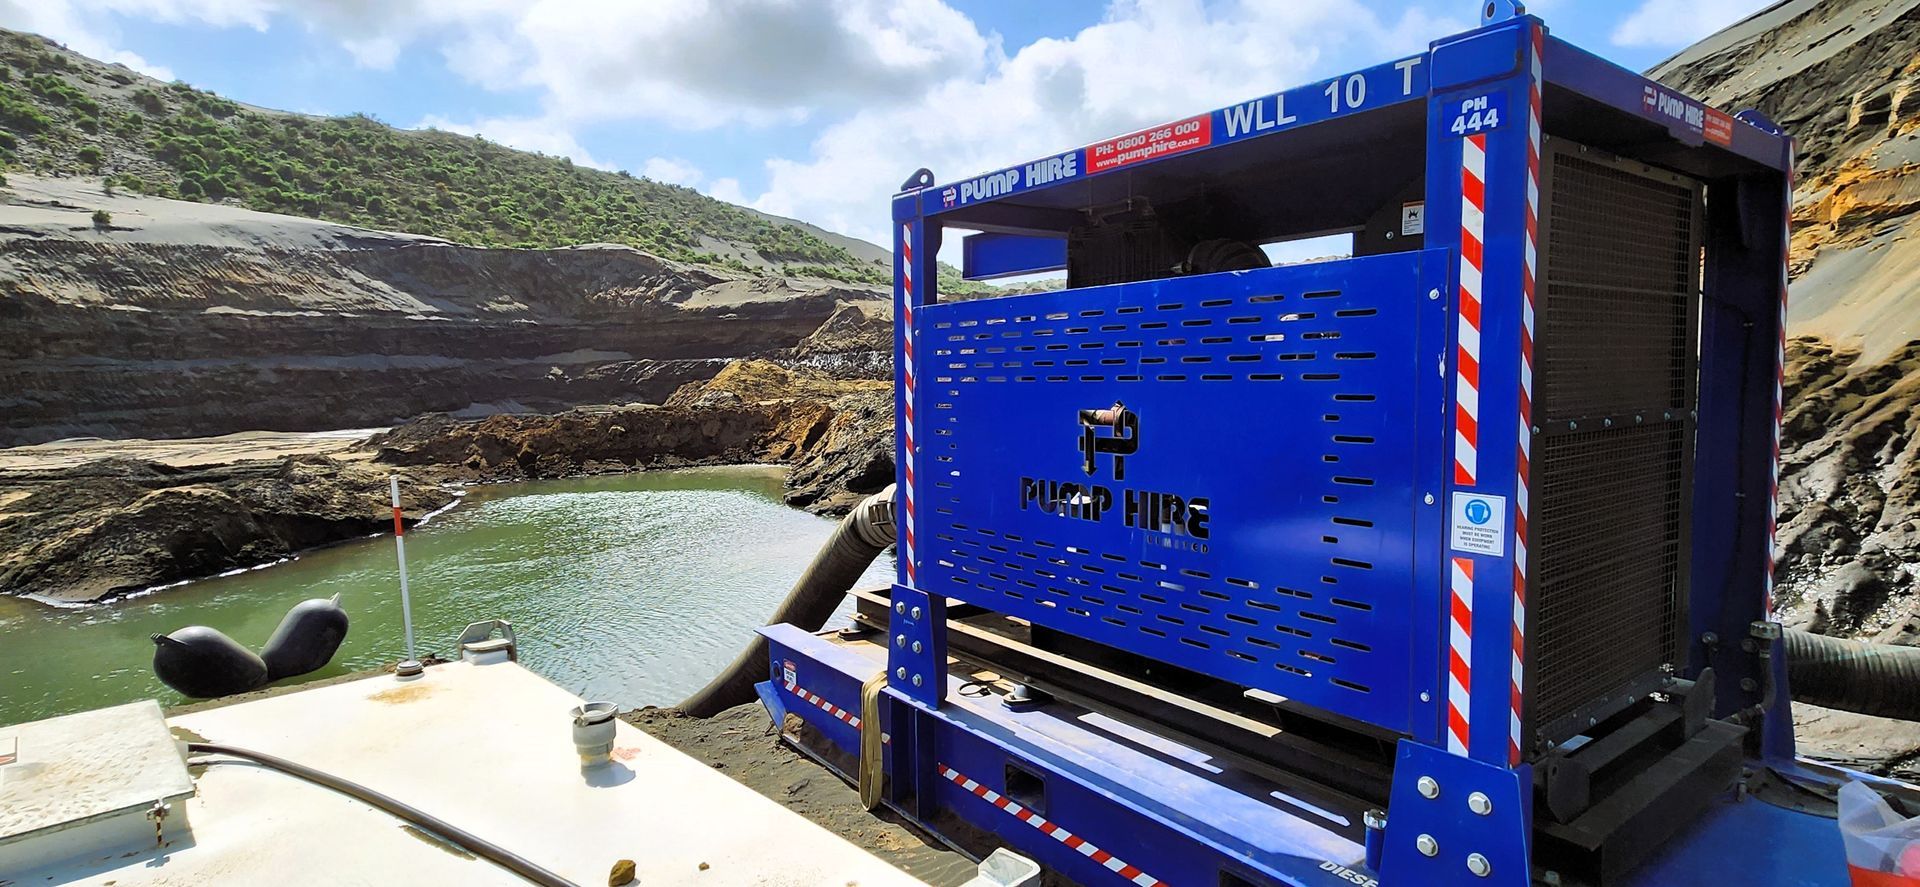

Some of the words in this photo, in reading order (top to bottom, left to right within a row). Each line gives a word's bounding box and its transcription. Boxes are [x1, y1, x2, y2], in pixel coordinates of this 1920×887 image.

[1223, 94, 1297, 138] WLL
[1323, 74, 1367, 113] 10
[1395, 57, 1422, 97] T
[1462, 96, 1488, 114] PH
[1658, 92, 1685, 120] PUMP
[1685, 104, 1704, 129] HIRE
[1095, 143, 1115, 157] PH:
[1116, 134, 1146, 151] 0800
[1149, 127, 1172, 143] 266
[1174, 120, 1200, 136] 000
[1451, 108, 1499, 135] 444
[1095, 136, 1200, 168] www.pumphire.co.nz
[960, 170, 1020, 204] PUMP
[1026, 152, 1077, 187] HIRE
[1020, 476, 1113, 523] PUMP
[1123, 488, 1211, 541] HIRE
[1146, 534, 1210, 554] LIMITED
